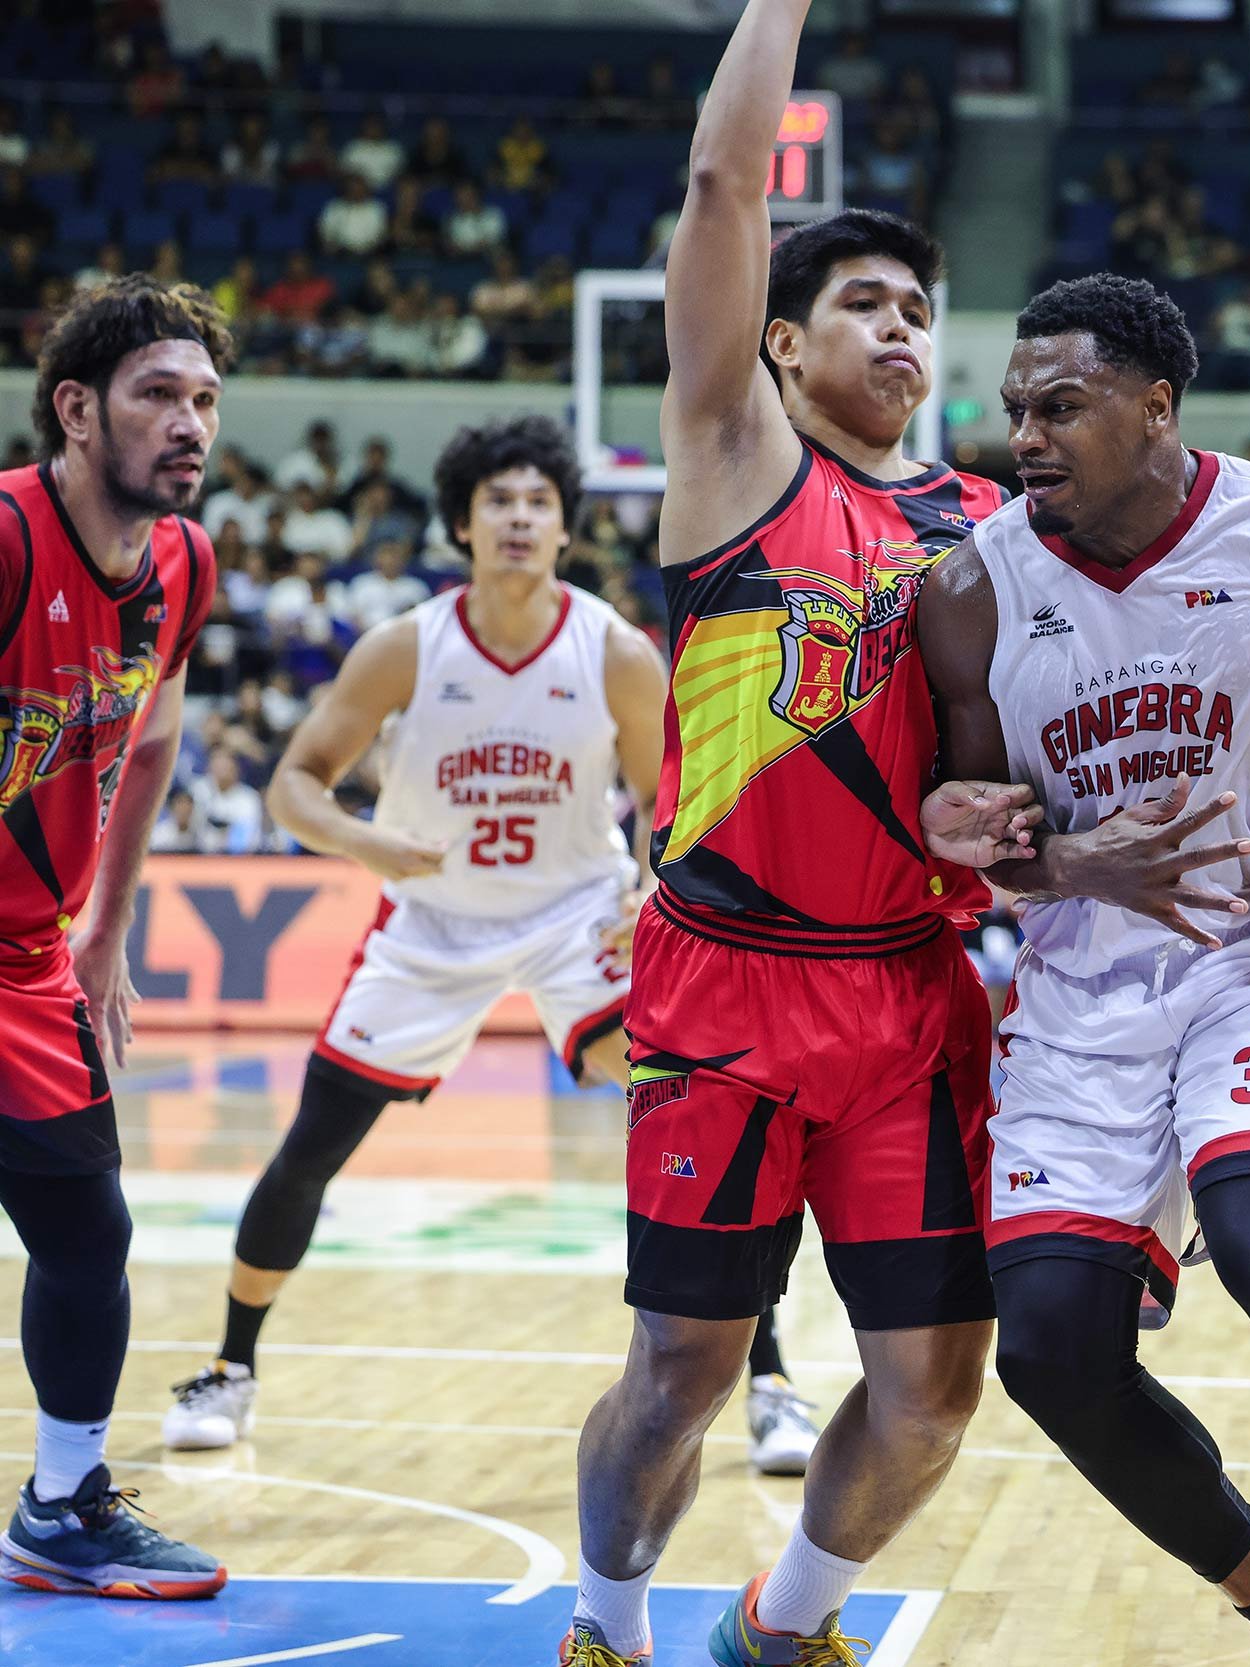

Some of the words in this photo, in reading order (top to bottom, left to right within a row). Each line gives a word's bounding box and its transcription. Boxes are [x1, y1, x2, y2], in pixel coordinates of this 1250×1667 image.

[1184, 588, 1234, 609] PBA
[1075, 660, 1199, 697] BARANGAY
[1041, 682, 1234, 774] GINEBRA
[437, 743, 574, 794] GINEBRA
[1118, 744, 1214, 790] MIGUEL
[469, 815, 537, 867] 25
[661, 1152, 697, 1178] PBA
[1007, 1168, 1051, 1192] PBA
